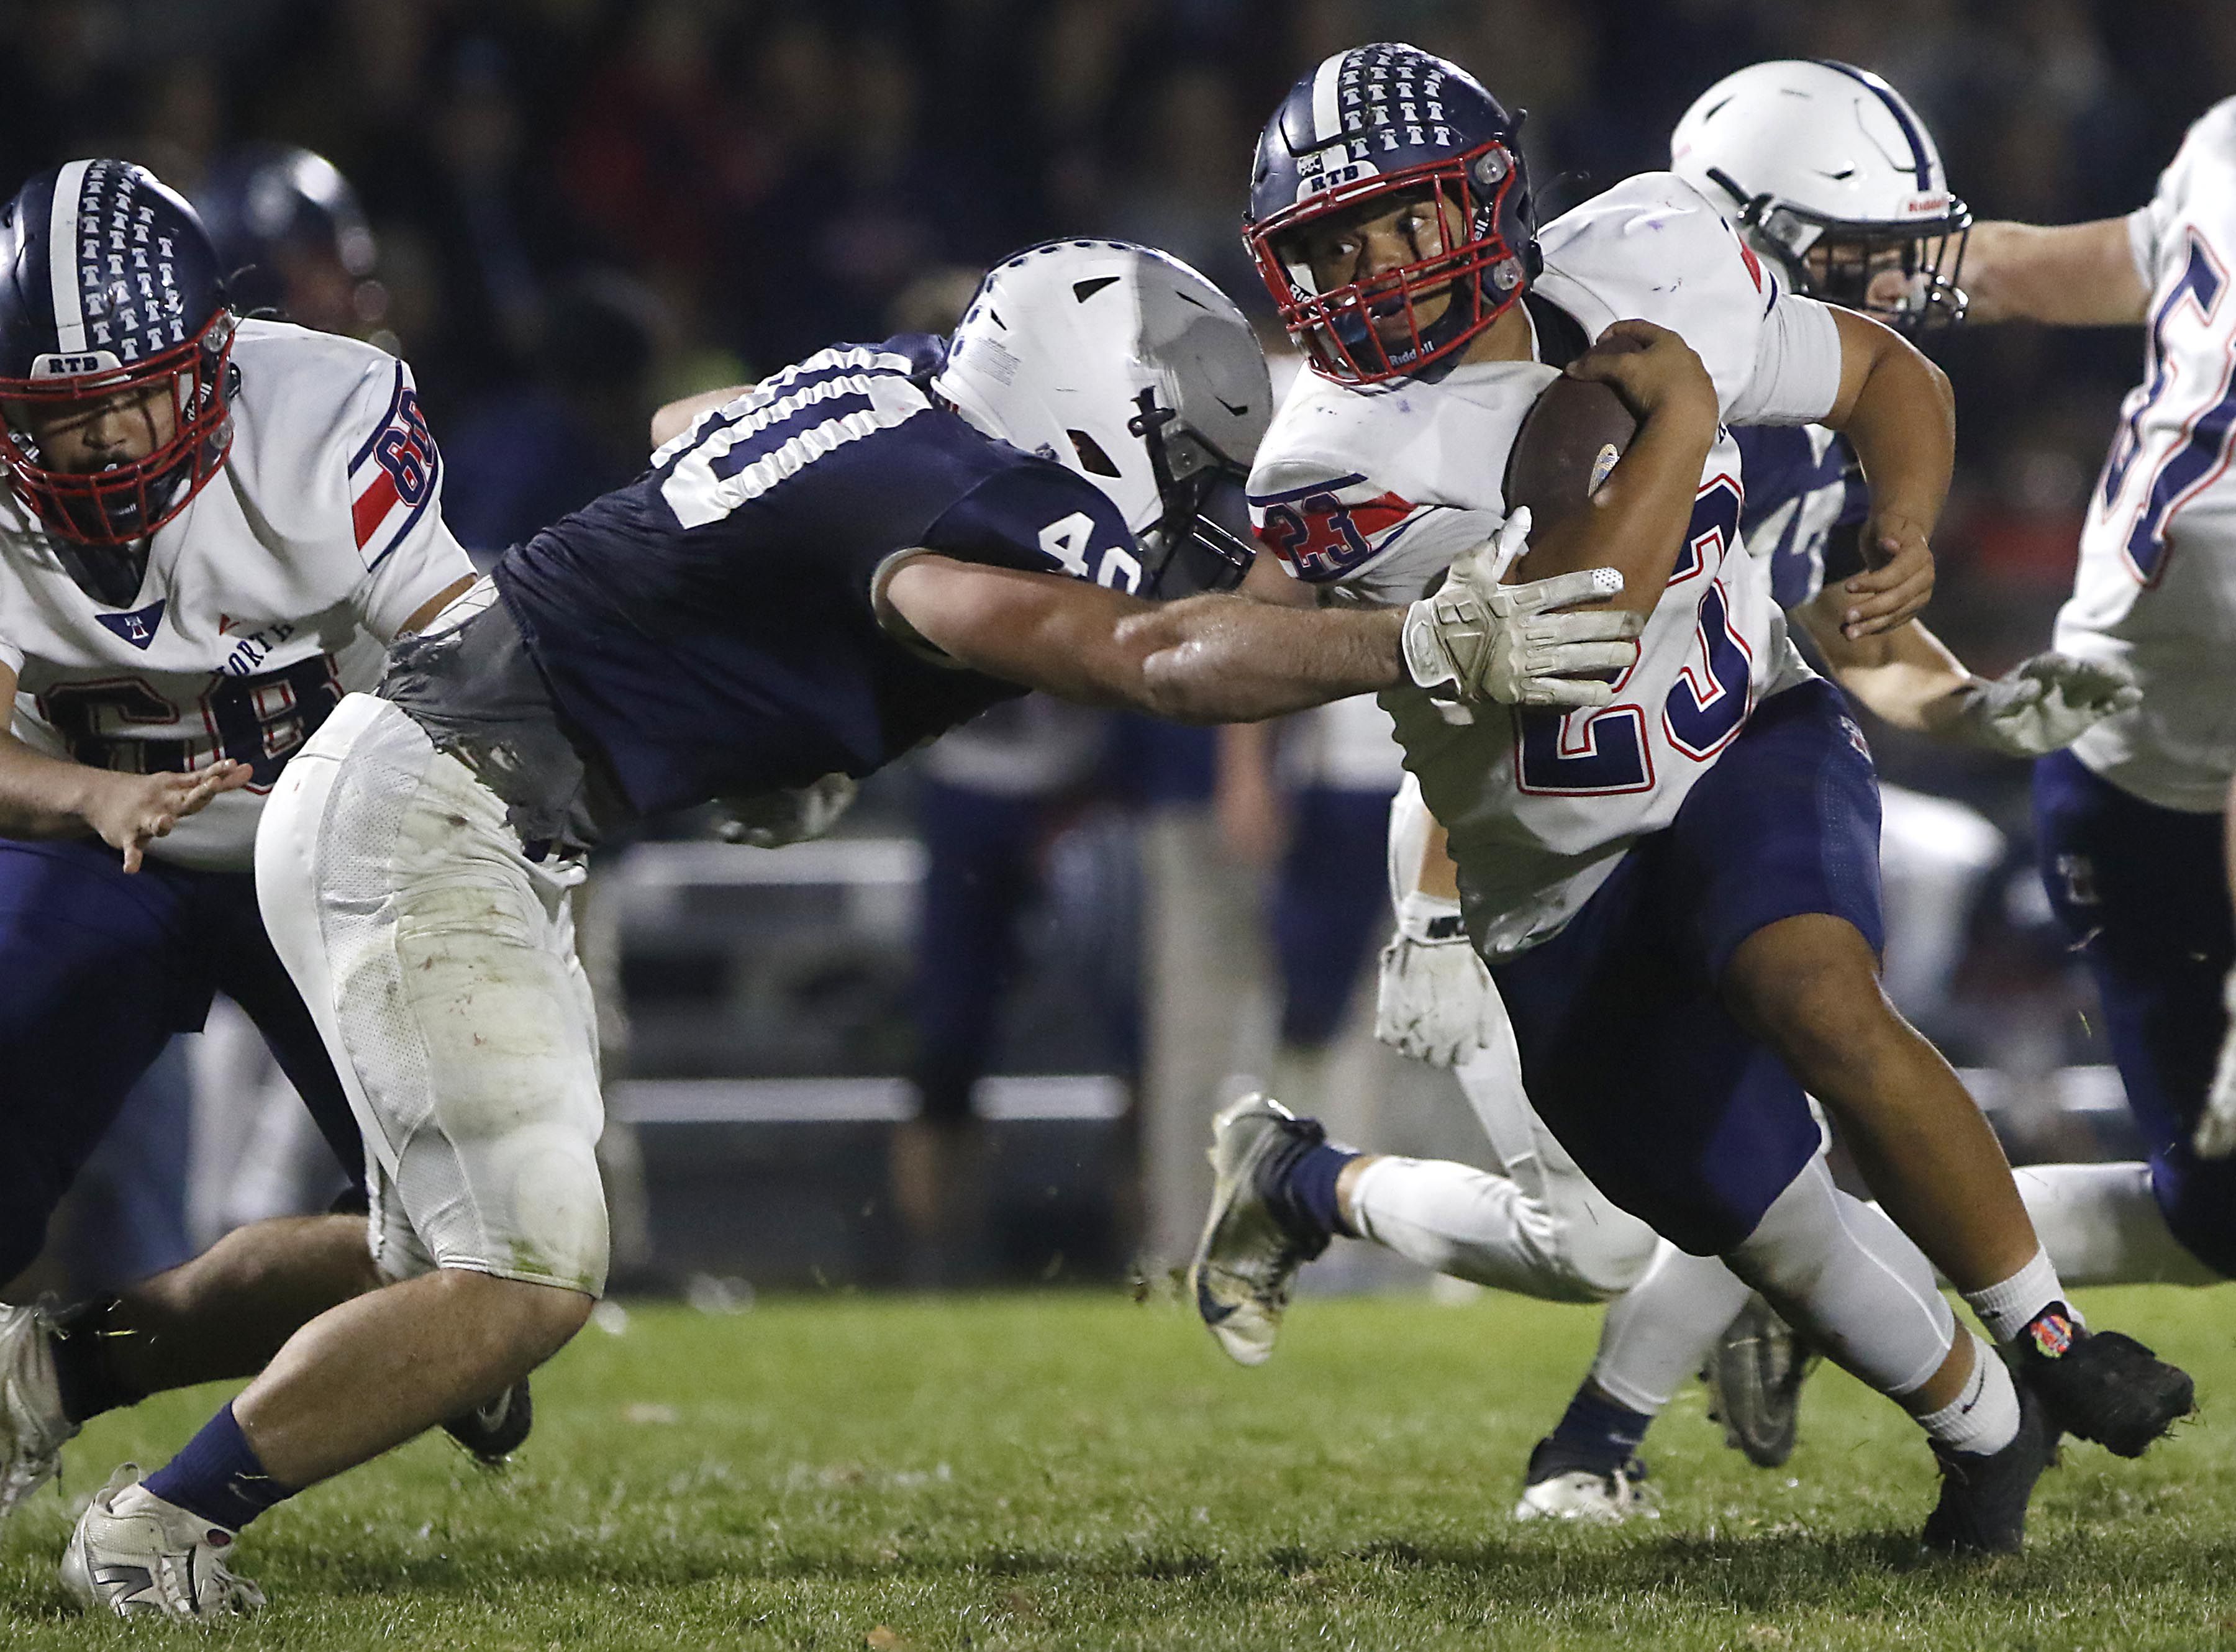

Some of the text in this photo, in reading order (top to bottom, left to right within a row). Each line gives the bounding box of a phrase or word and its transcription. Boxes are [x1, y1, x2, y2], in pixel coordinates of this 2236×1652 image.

[1311, 165, 1359, 193] RTB
[48, 356, 98, 373] RTB
[1263, 491, 1373, 573] 23
